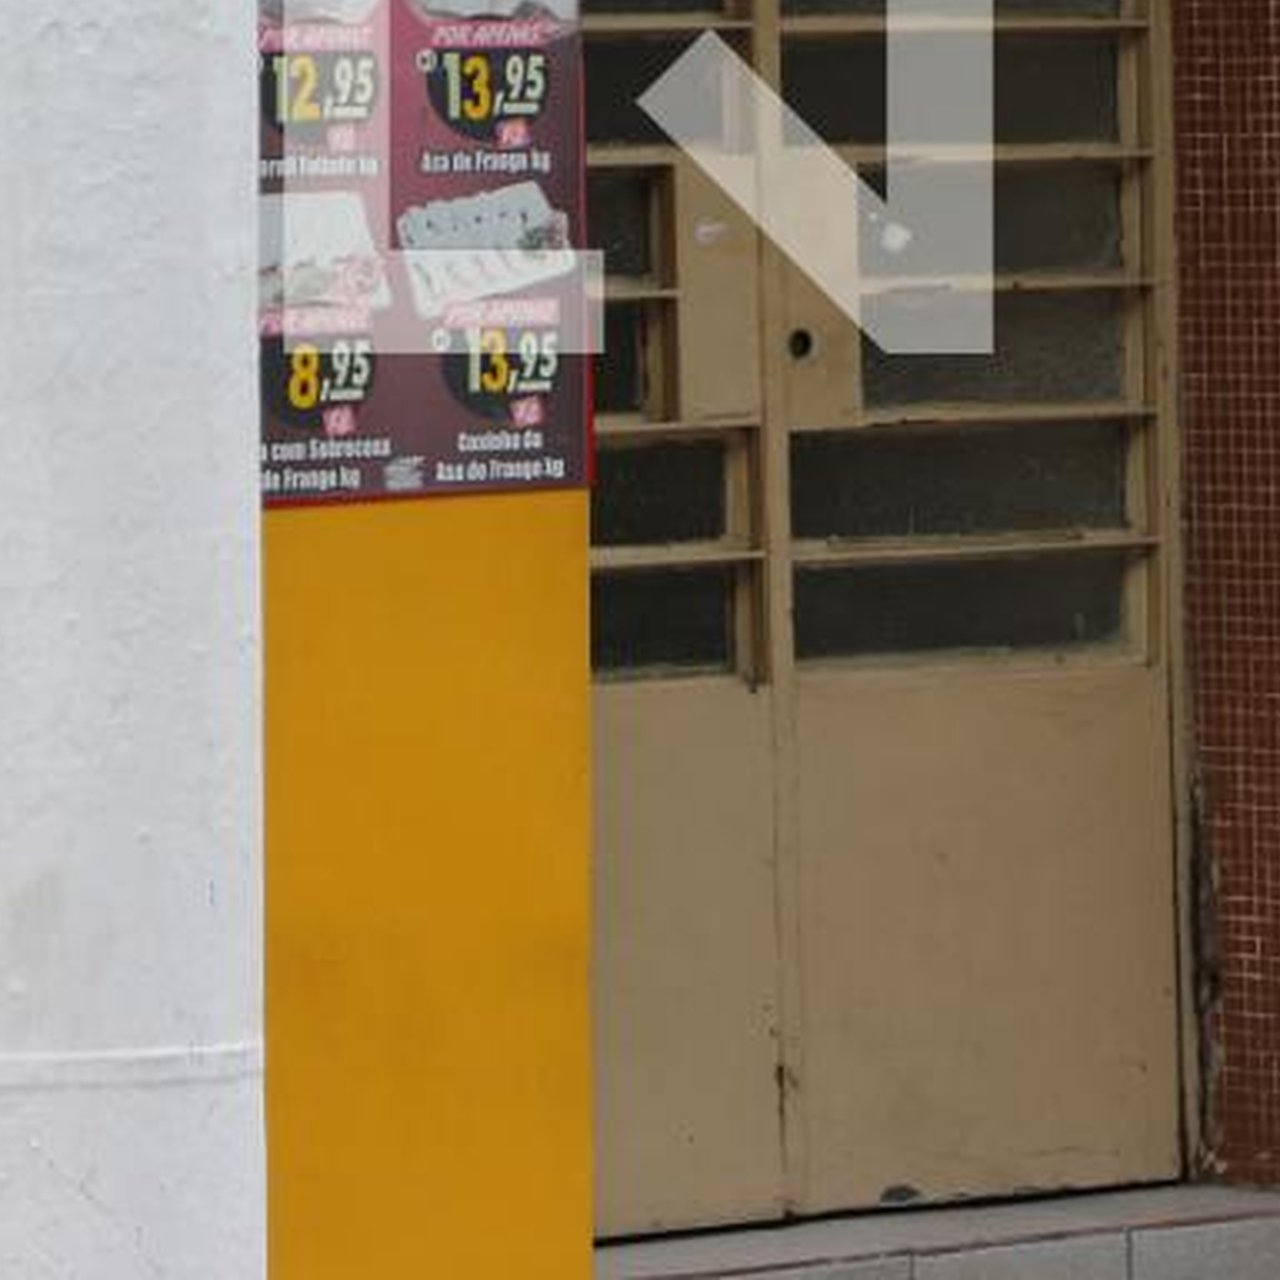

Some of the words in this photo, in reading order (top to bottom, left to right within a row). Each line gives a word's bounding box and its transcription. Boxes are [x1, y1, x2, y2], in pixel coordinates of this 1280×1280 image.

[273, 55, 374, 123] 12,95
[442, 52, 546, 121] 13,95
[287, 342, 371, 410] 8,95
[466, 327, 558, 392] 13,95
